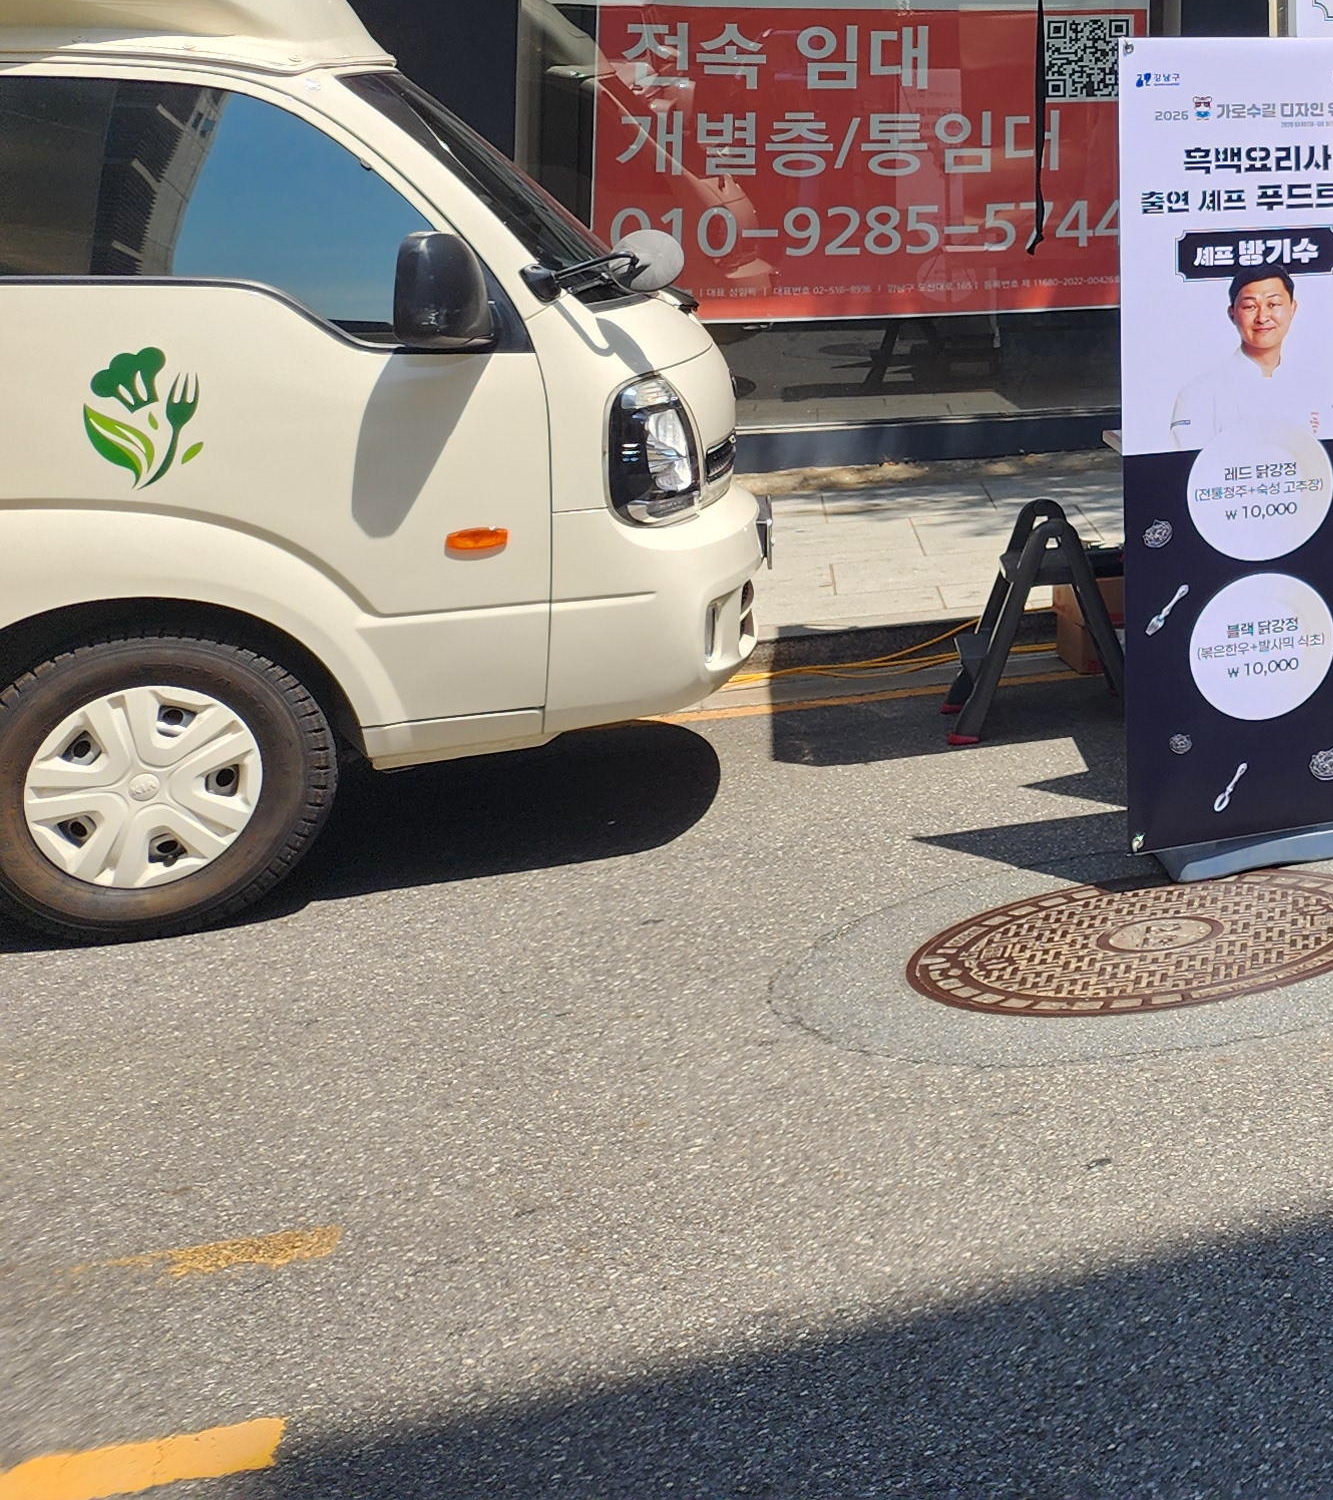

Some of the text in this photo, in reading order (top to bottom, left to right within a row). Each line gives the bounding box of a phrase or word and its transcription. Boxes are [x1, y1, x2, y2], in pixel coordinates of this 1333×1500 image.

[620, 22, 930, 92] 전속 임대
[1153, 72, 1181, 83] 강남구
[1154, 110, 1190, 122] 2026
[1216, 102, 1277, 120] 가로수길
[1280, 101, 1325, 119] 디자인
[616, 109, 1061, 178] 개별층/통임대
[1183, 144, 1333, 175] 흑백요리사
[1140, 189, 1191, 215] 출연
[1197, 188, 1247, 213] 셰프
[1193, 237, 1320, 267] 셰프 방기수
[1224, 461, 1298, 482] 레드 닭강정
[1241, 501, 1298, 520] 10,000
[1226, 616, 1299, 639] 블랙 닭강정
[1297, 632, 1325, 649] 식초)
[1243, 657, 1300, 677] 10,000
